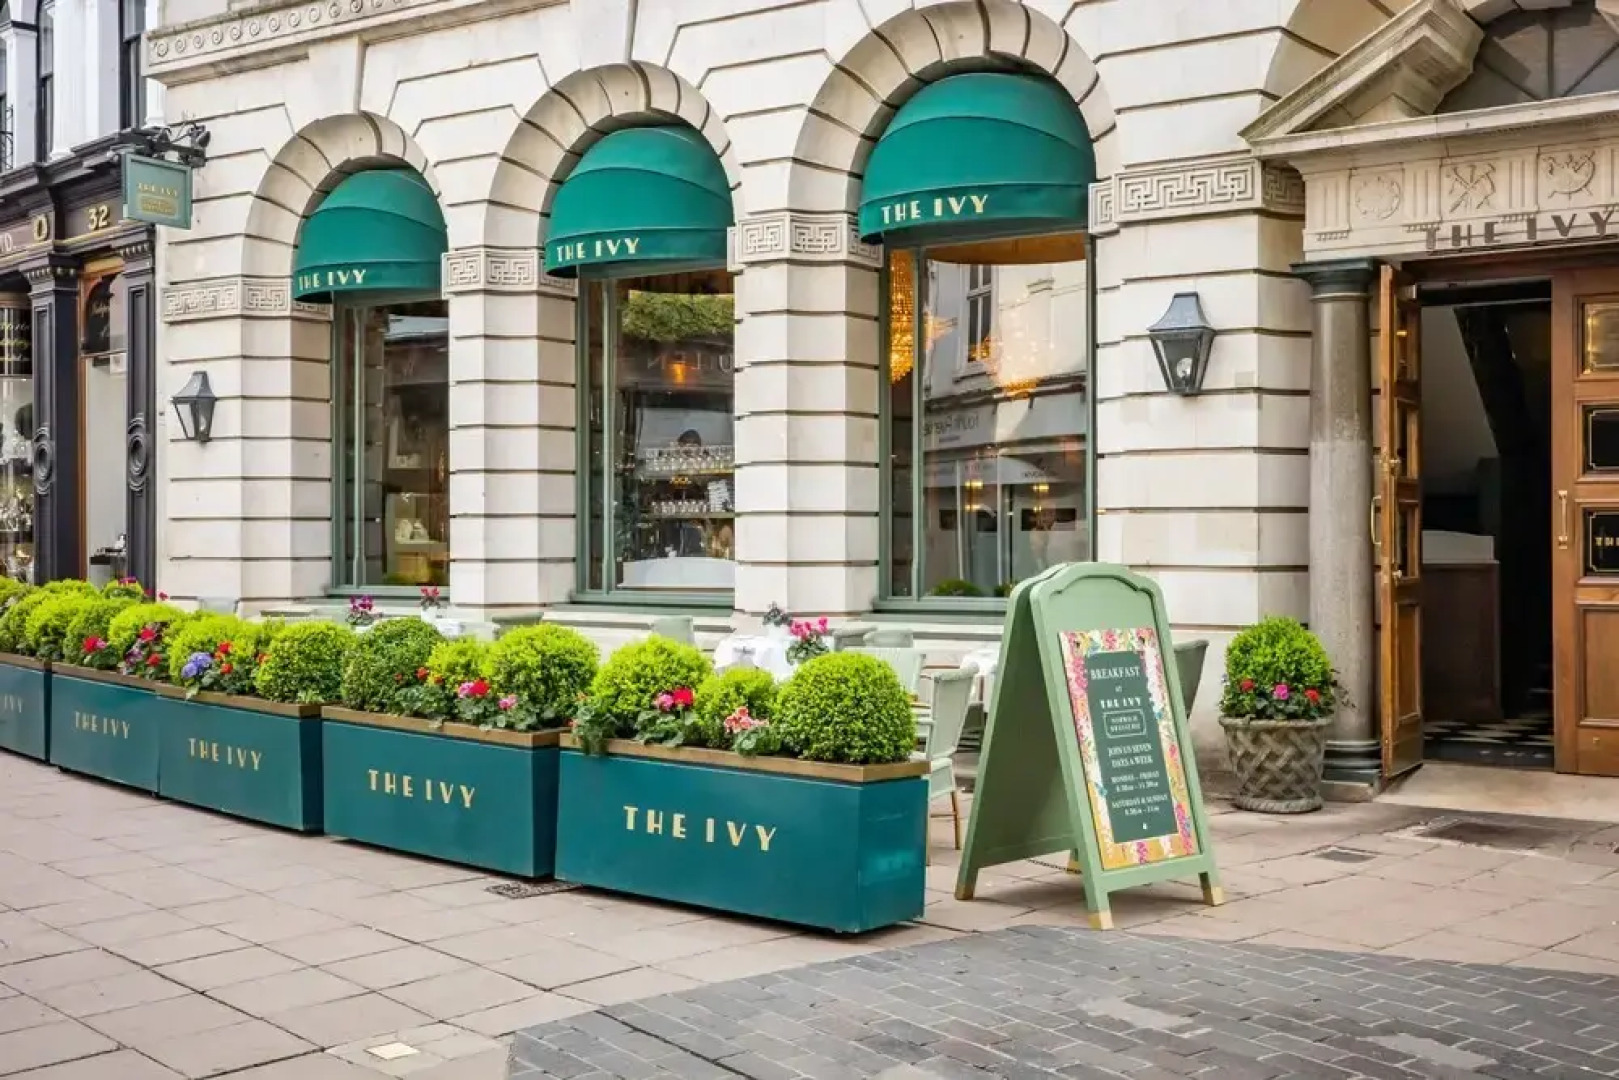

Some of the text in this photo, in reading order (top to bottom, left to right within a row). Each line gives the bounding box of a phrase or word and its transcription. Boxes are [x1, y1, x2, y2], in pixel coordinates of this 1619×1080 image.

[88, 205, 109, 231] 32
[881, 194, 988, 224] THE IVY
[1425, 210, 1615, 250] THE IVY
[557, 237, 641, 263] THE IVY
[299, 269, 367, 290] THE IVY
[1090, 666, 1140, 680] BREAKFAST
[1123, 697, 1141, 706] IVY
[75, 711, 130, 739] THE IVY
[189, 738, 262, 771] THE IVY
[368, 769, 475, 808] THE IVY
[623, 805, 777, 851] THE IVY
